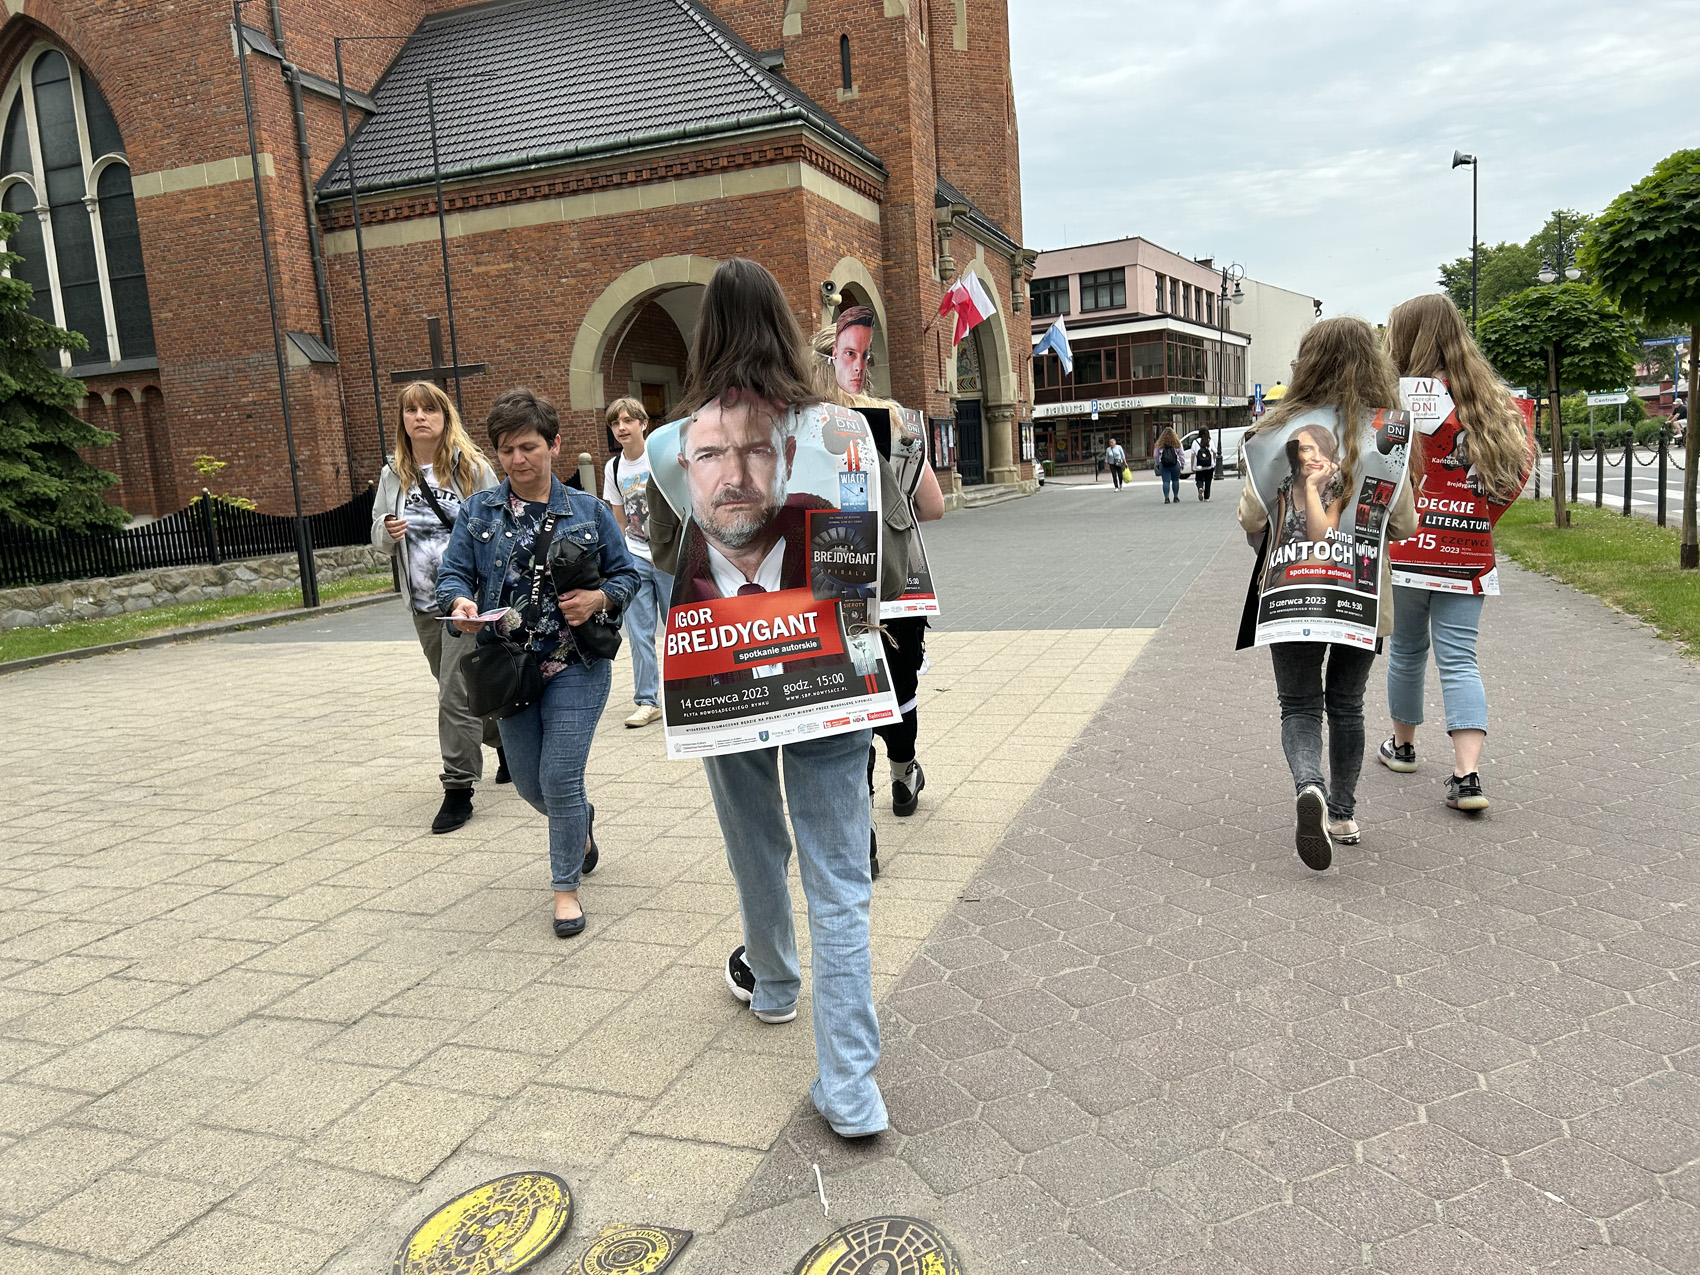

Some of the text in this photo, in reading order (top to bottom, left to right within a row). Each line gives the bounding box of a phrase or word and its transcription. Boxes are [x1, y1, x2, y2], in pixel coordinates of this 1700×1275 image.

[1045, 398, 1143, 416] natura ROGERIA
[1412, 402, 1436, 412] DNI
[836, 420, 860, 430] DNI
[1388, 426, 1406, 436] DNI
[840, 474, 865, 484] WIATR
[1414, 497, 1475, 514] DECKIE
[1324, 526, 1352, 544] Anna
[1389, 533, 1436, 550] -15
[1442, 536, 1489, 547] czerwca
[814, 550, 876, 565] BREJDYGANT
[1269, 538, 1354, 570] KAŃTOCH
[1440, 546, 1460, 554] 2023
[1290, 568, 1352, 579] spotkanie autorskie
[1276, 598, 1302, 607] czerwca
[1305, 596, 1327, 604] 2023
[1337, 600, 1351, 608] godz.
[1352, 602, 1363, 611] 9:30
[676, 608, 713, 628] IGOR
[668, 612, 818, 656] BREJDYGANT
[739, 640, 818, 660] spotkanie autorskie
[680, 672, 845, 709] 14 czerwca 2023 godz. 15:00
